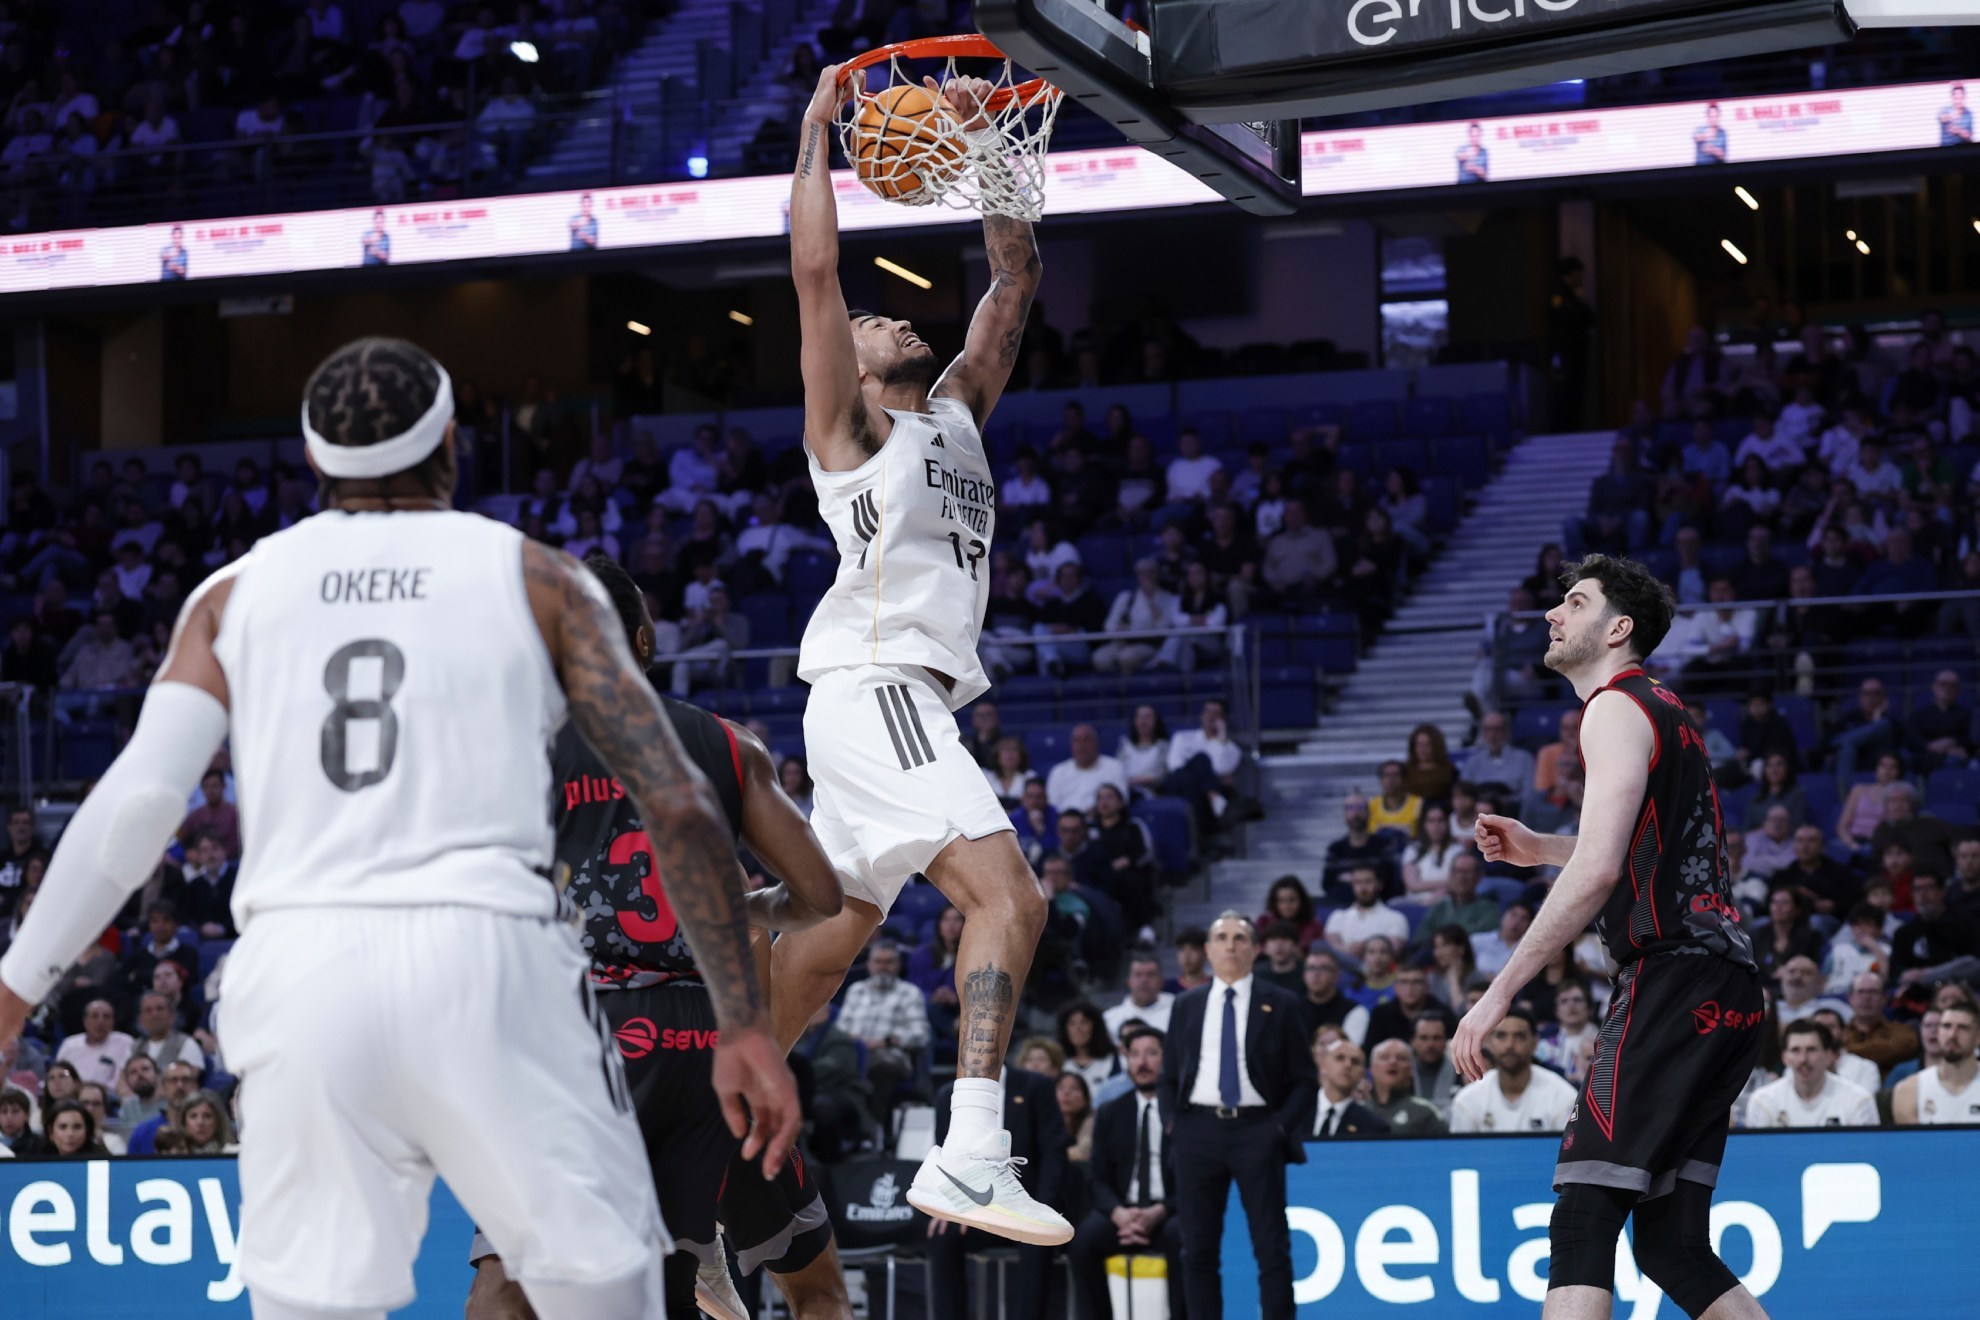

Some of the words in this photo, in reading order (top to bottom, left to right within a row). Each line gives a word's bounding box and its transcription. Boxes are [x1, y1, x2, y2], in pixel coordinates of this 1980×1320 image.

[924, 458, 994, 508] Emirate
[321, 567, 433, 603] OKEKE
[321, 638, 405, 792] 8
[609, 831, 679, 943] 3
[0, 1160, 246, 1302] elay
